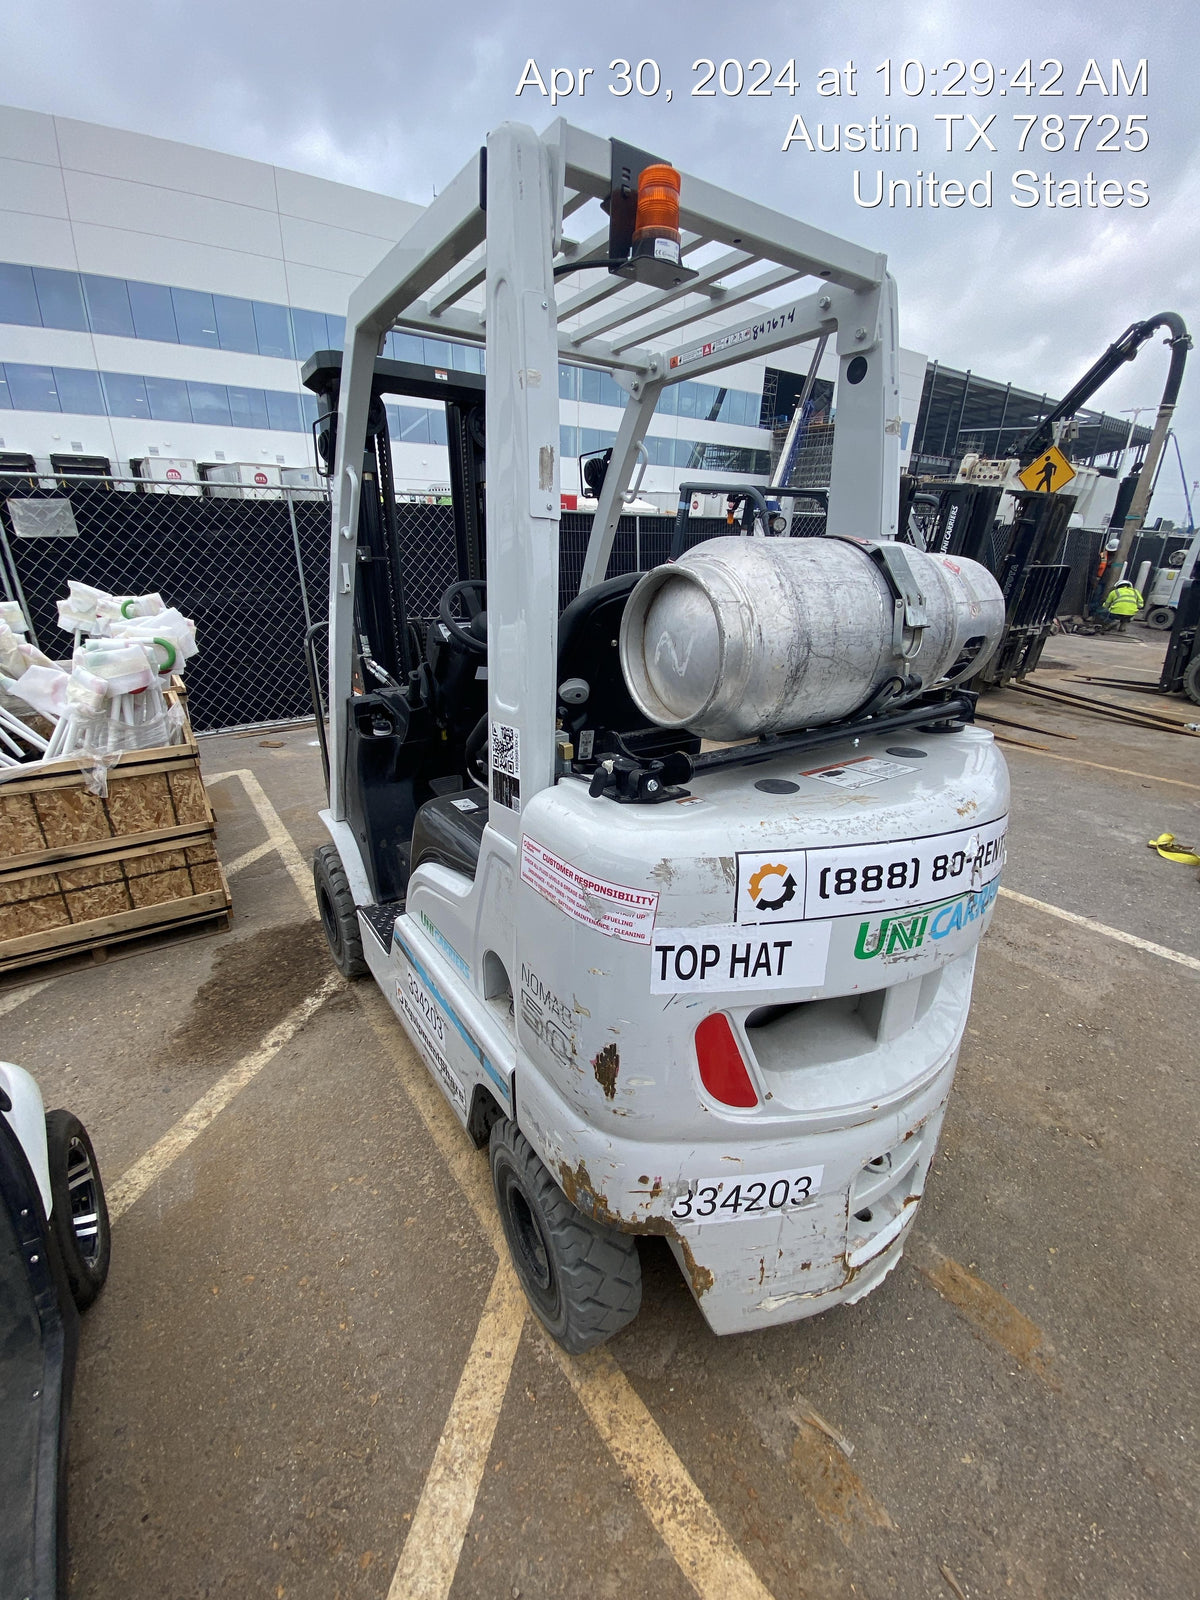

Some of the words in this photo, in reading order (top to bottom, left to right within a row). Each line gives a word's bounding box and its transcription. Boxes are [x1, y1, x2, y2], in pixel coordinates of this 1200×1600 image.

[752, 307, 796, 340] 847674
[940, 504, 959, 554] UNICARRIERS
[542, 853, 574, 880] CUSTOMER
[574, 873, 655, 906] RESPONSIBILITY
[819, 857, 920, 899] (888)
[573, 910, 610, 930] MAINTENANCE
[613, 927, 646, 939] CLEANING
[655, 944, 720, 981] TOP
[729, 940, 793, 979] HAT
[407, 972, 443, 1041] 334203
[671, 1175, 813, 1219] 334203
